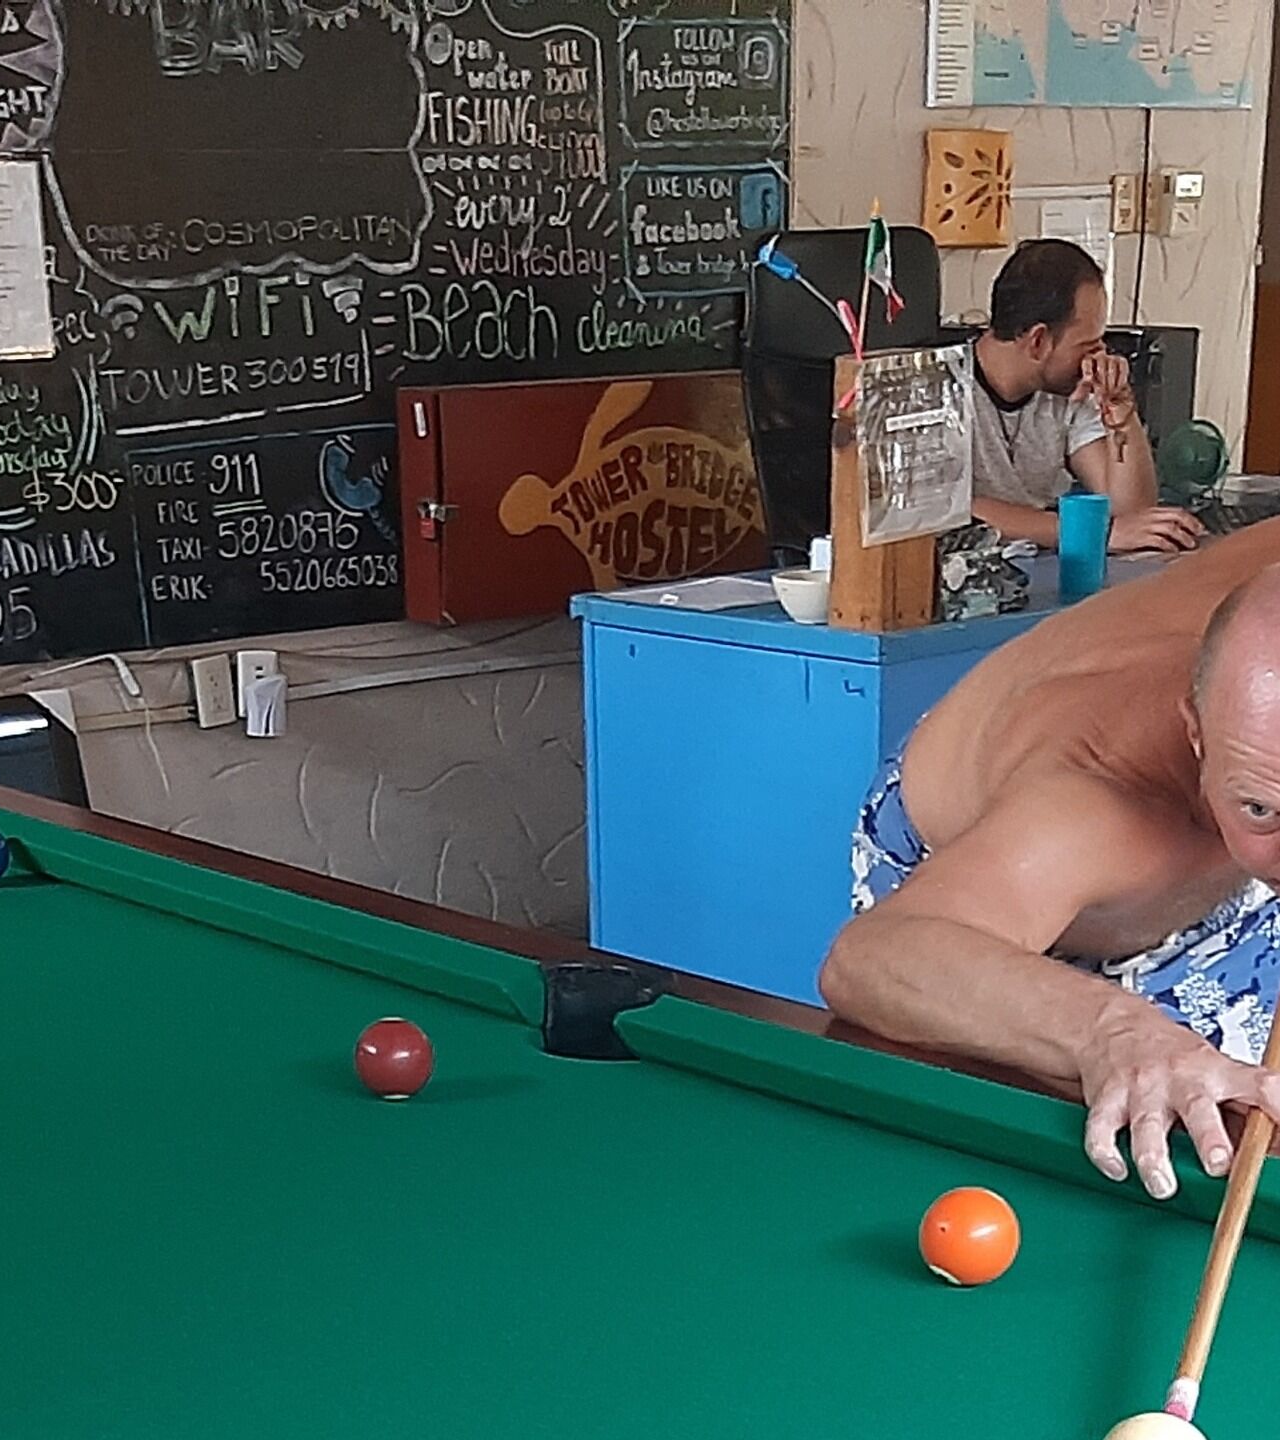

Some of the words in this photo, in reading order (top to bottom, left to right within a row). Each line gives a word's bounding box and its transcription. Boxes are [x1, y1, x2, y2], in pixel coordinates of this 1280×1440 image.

[425, 22, 492, 76] Open
[468, 51, 531, 91] water
[627, 48, 737, 106] Instagram
[427, 92, 536, 147] FISHING
[647, 176, 683, 197] LIKE
[686, 177, 706, 198] US
[709, 176, 733, 199] ON
[181, 215, 413, 253] COSMOPOLITAN
[630, 204, 742, 245] facebook
[400, 280, 559, 361] Beach
[209, 452, 262, 495] 911
[551, 445, 649, 536] TOWER
[665, 442, 758, 521] BRIDGE
[157, 500, 199, 524] FIRE
[588, 500, 744, 578] HOSTEL
